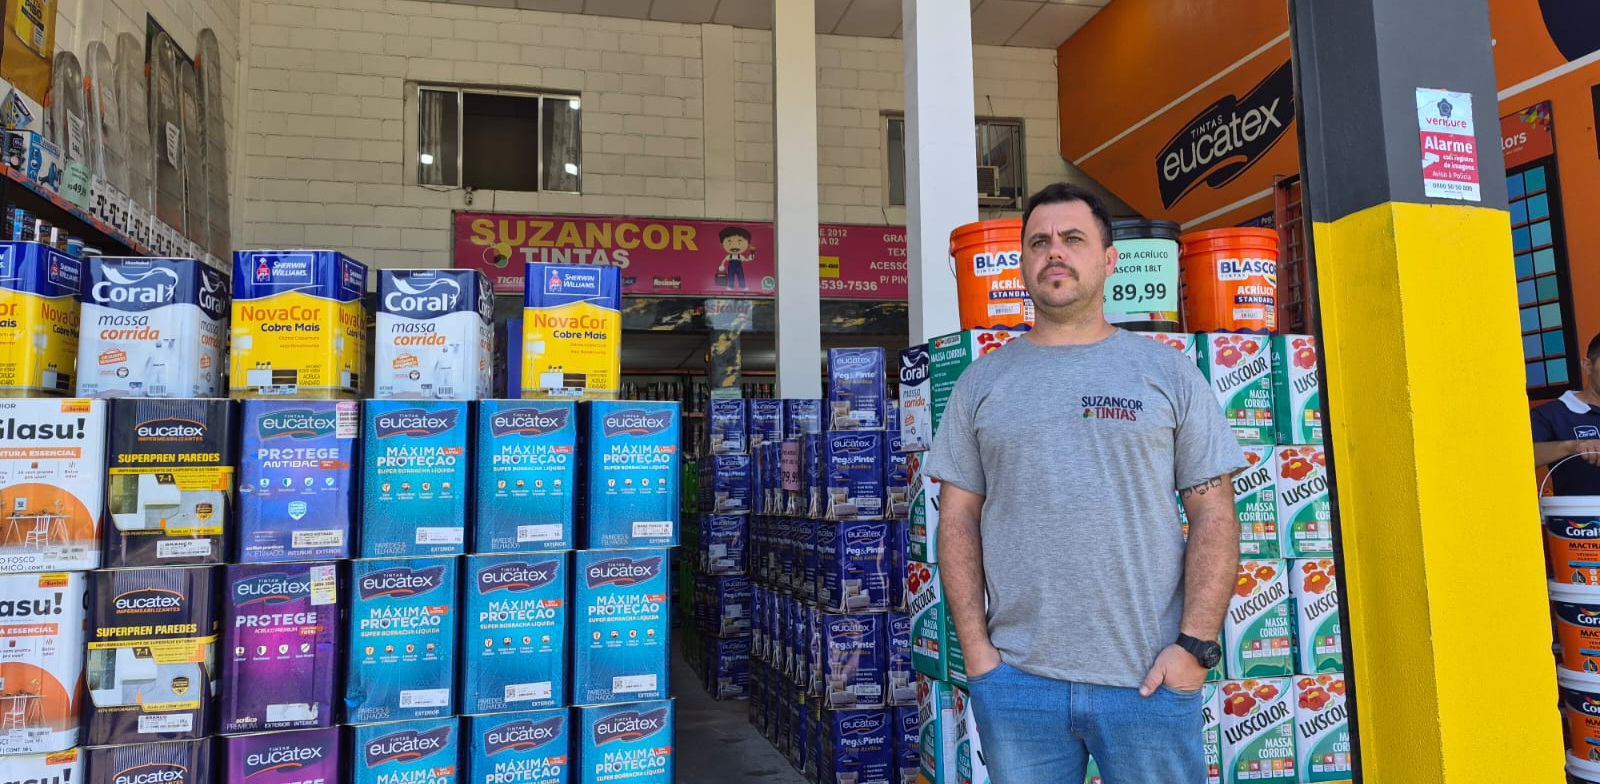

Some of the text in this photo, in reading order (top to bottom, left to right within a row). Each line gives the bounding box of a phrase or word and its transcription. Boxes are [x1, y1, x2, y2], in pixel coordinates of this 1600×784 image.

[1190, 115, 1223, 138] TINTAS
[1426, 117, 1467, 128] verisure
[1164, 97, 1282, 181] eucatex
[1425, 136, 1472, 153] Alarme
[471, 219, 698, 250] SUZANCOR
[520, 248, 630, 268] TINTAS
[976, 254, 1020, 269] BLAS
[272, 261, 306, 269] SHERWIN
[272, 268, 307, 276] WILLIAMS
[563, 280, 595, 288] WILLIAMS
[821, 281, 878, 291] 539-7536
[892, 276, 907, 284] PIN
[992, 278, 1024, 289] ACRÍL
[92, 282, 164, 303] Coral
[1113, 283, 1166, 303] 89,99
[1238, 284, 1273, 295] ACRÍLICO
[385, 292, 448, 311] Coral
[1239, 296, 1273, 304] STANDARD
[42, 303, 80, 326] NovaCo
[241, 305, 320, 322] NovaCor
[98, 315, 149, 326] massa
[534, 313, 607, 329] NovaCor
[100, 326, 160, 340] corrida
[261, 323, 320, 332] Cobre Mais
[392, 323, 436, 333] massa
[393, 332, 446, 346] corrida
[553, 330, 607, 339] Cobre Mais
[900, 365, 925, 381] Coral
[1216, 356, 1268, 393] LUKSCOLOR
[1249, 389, 1269, 399] MASSA
[1082, 396, 1143, 411] SUZANCOR
[1244, 398, 1271, 408] CORRIDA
[1095, 407, 1136, 421] TINTAS
[263, 417, 336, 429] eucatex
[380, 416, 448, 428] eucatex
[495, 416, 558, 427] eucatex
[607, 416, 664, 428] eucatex
[138, 425, 203, 437] eucatex
[258, 448, 339, 460] PROTEGE
[387, 445, 444, 457] MÁXIMA
[502, 443, 555, 455] MÁXIMA
[611, 443, 660, 454] MÁXIMA
[118, 453, 220, 463] SUPERPREN PAREDES
[263, 460, 318, 468] ANTIBAC
[832, 456, 874, 464] Peg&Pinte
[1232, 467, 1272, 496] COLOR
[1246, 502, 1274, 511] MASSA
[1239, 511, 1275, 521] CORRIDA
[1566, 526, 1597, 536] Coral
[482, 568, 548, 583] eucatex
[590, 563, 652, 578] eucatex
[237, 580, 310, 595] eucatex
[363, 574, 433, 590] eucatex
[0, 592, 62, 617] asu!
[116, 596, 180, 609] eucatex
[489, 598, 545, 611] MÁXIMA
[597, 592, 650, 605] MÁXIMA
[1229, 581, 1286, 625] LUKSCOLOR
[370, 605, 430, 619] MÁXIMA
[236, 612, 317, 627] PROTEGE
[1265, 617, 1287, 627] MASSA
[96, 624, 197, 637] SUPERPREN PAREDES
[831, 623, 869, 632] eucatex
[1259, 627, 1288, 637] CORRIDA
[830, 641, 875, 650] Peg&Pinte
[597, 717, 658, 735] eucatex
[842, 719, 879, 728] eucatex
[1224, 701, 1290, 745] LUKSCOLOR
[488, 726, 553, 745] eucatex
[841, 737, 884, 747] Peg&Pinte
[369, 737, 440, 756] eucatex
[1265, 738, 1292, 747] MASSA
[247, 746, 322, 766] eucatex
[604, 747, 656, 762] MÁXIMA
[1258, 748, 1293, 759] CORRIDA
[494, 756, 550, 772] MÁXIMA
[115, 769, 184, 784] eucatex
[377, 768, 436, 784] MÁXIMA
